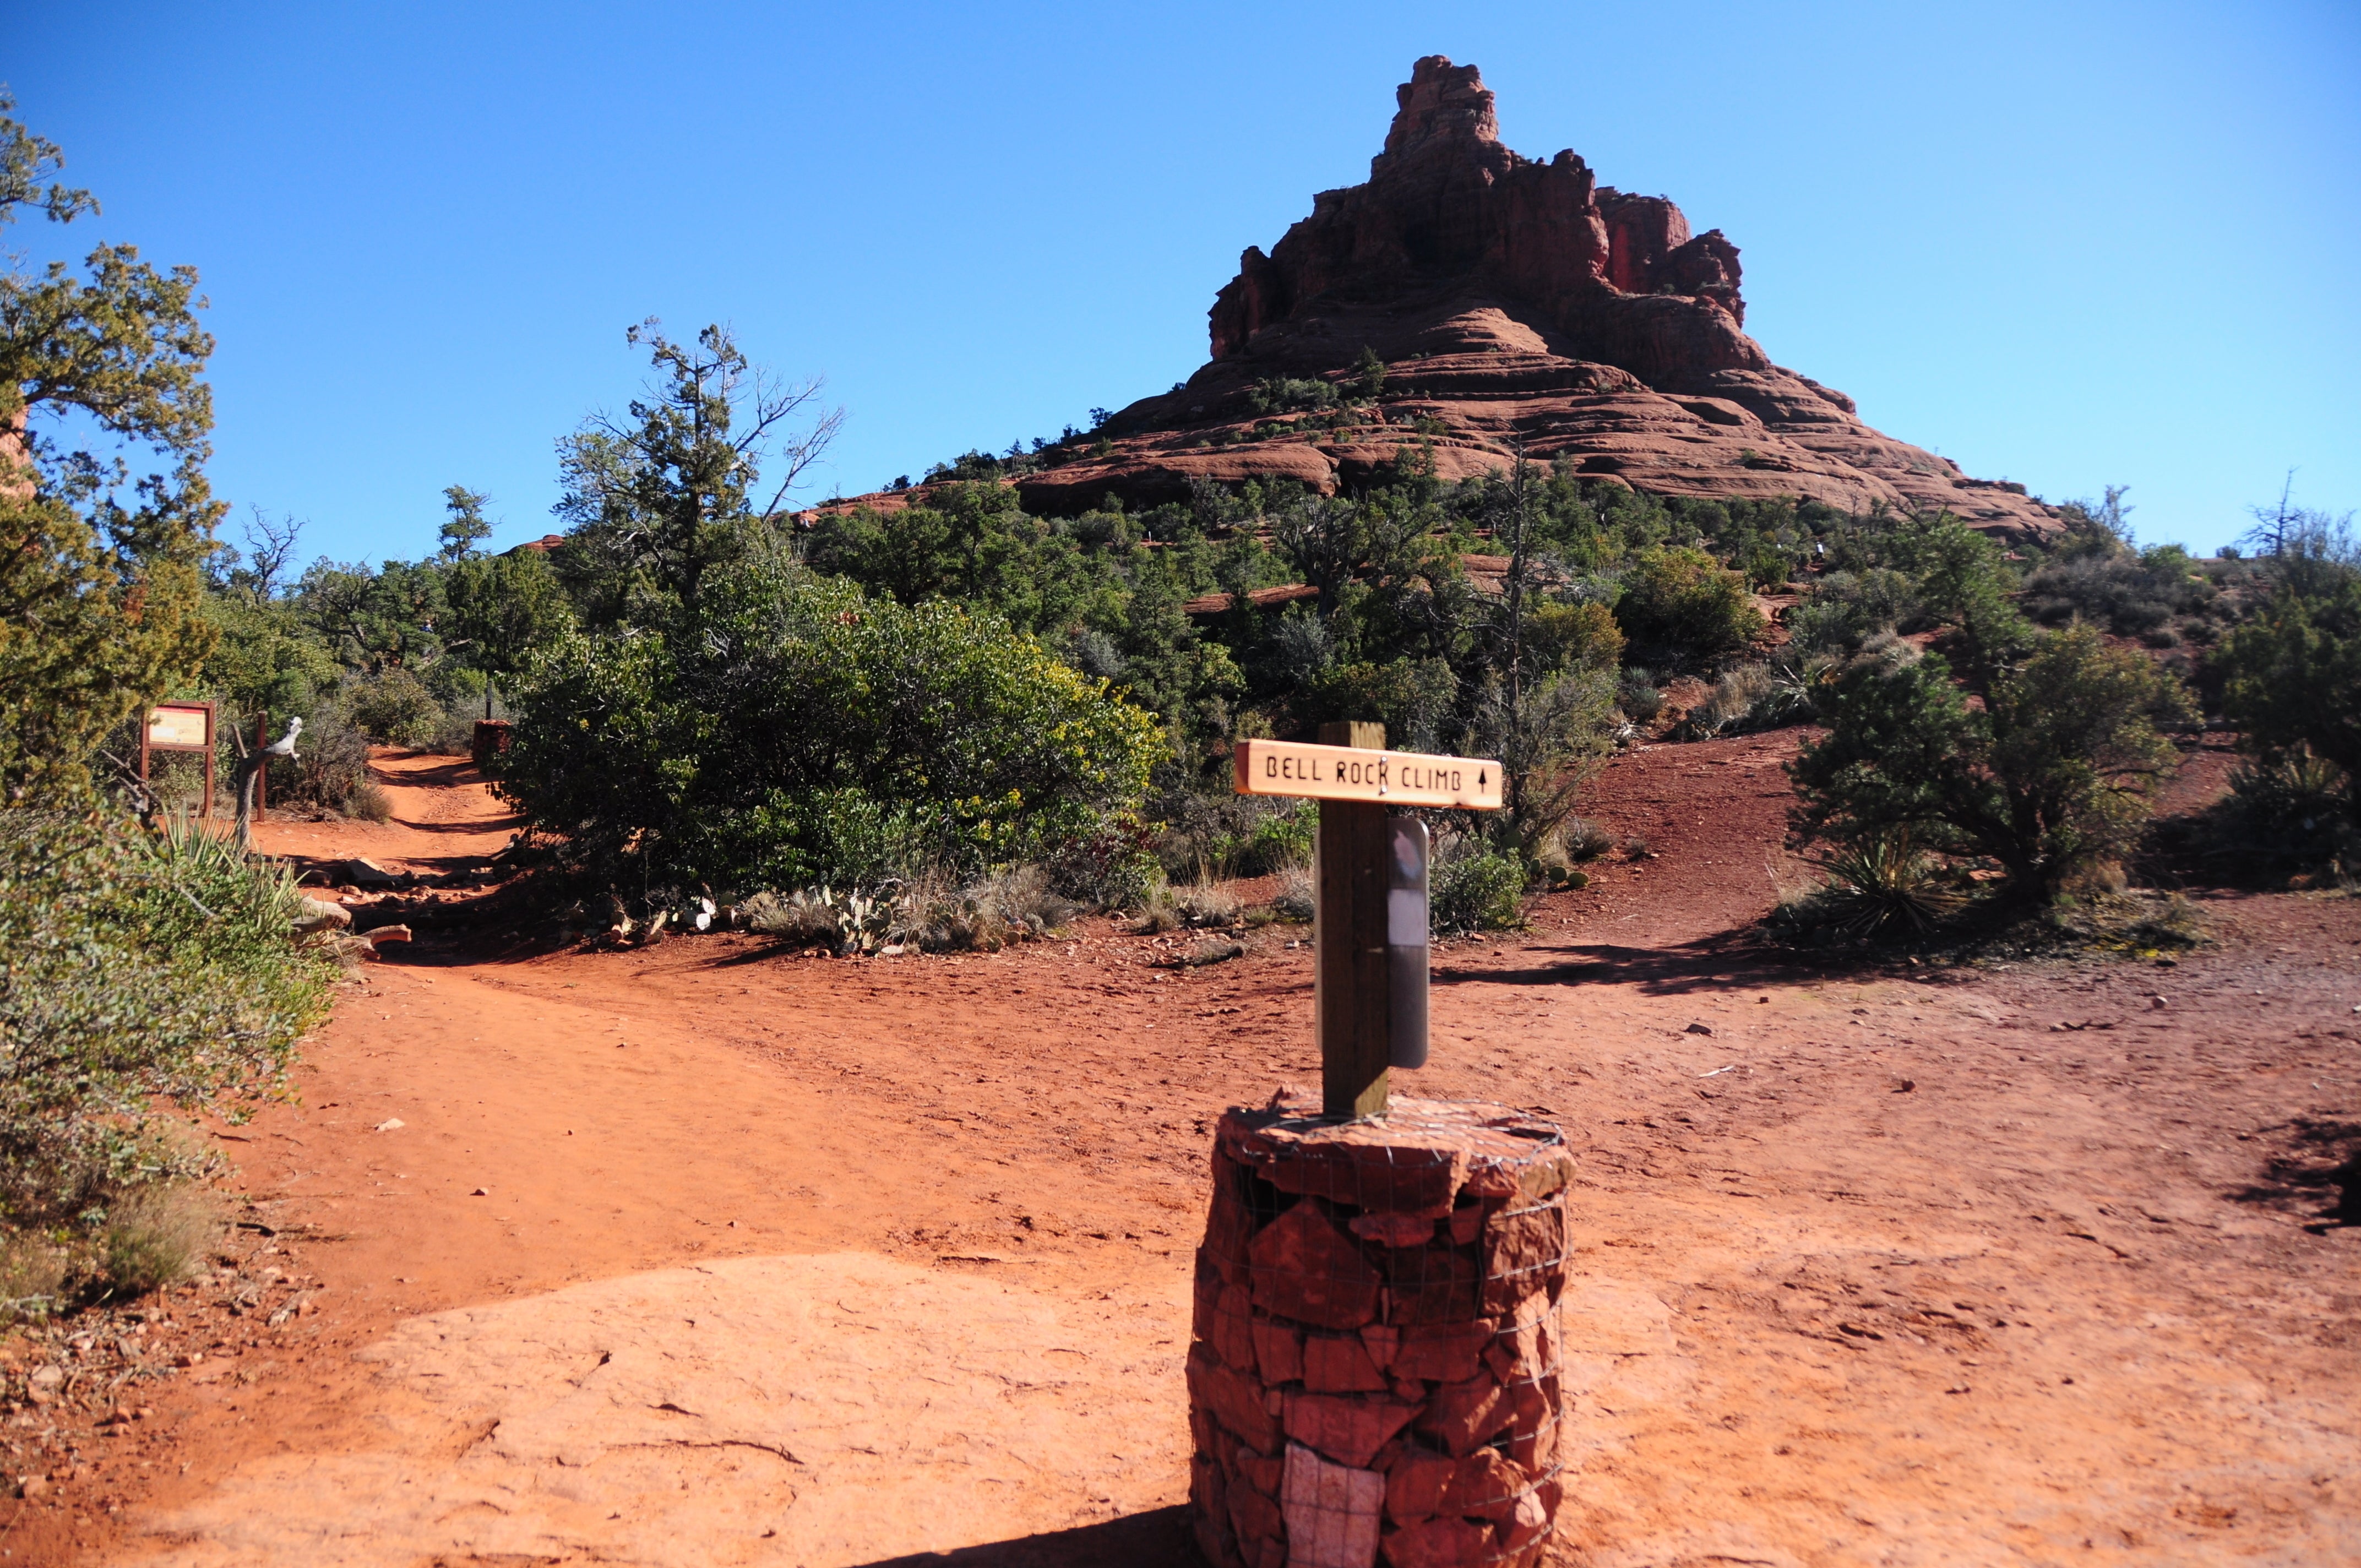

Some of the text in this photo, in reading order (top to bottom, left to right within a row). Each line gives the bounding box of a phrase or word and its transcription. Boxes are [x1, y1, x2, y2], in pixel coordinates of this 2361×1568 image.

[1266, 756, 1461, 791] BELL ROCK CLIMB
